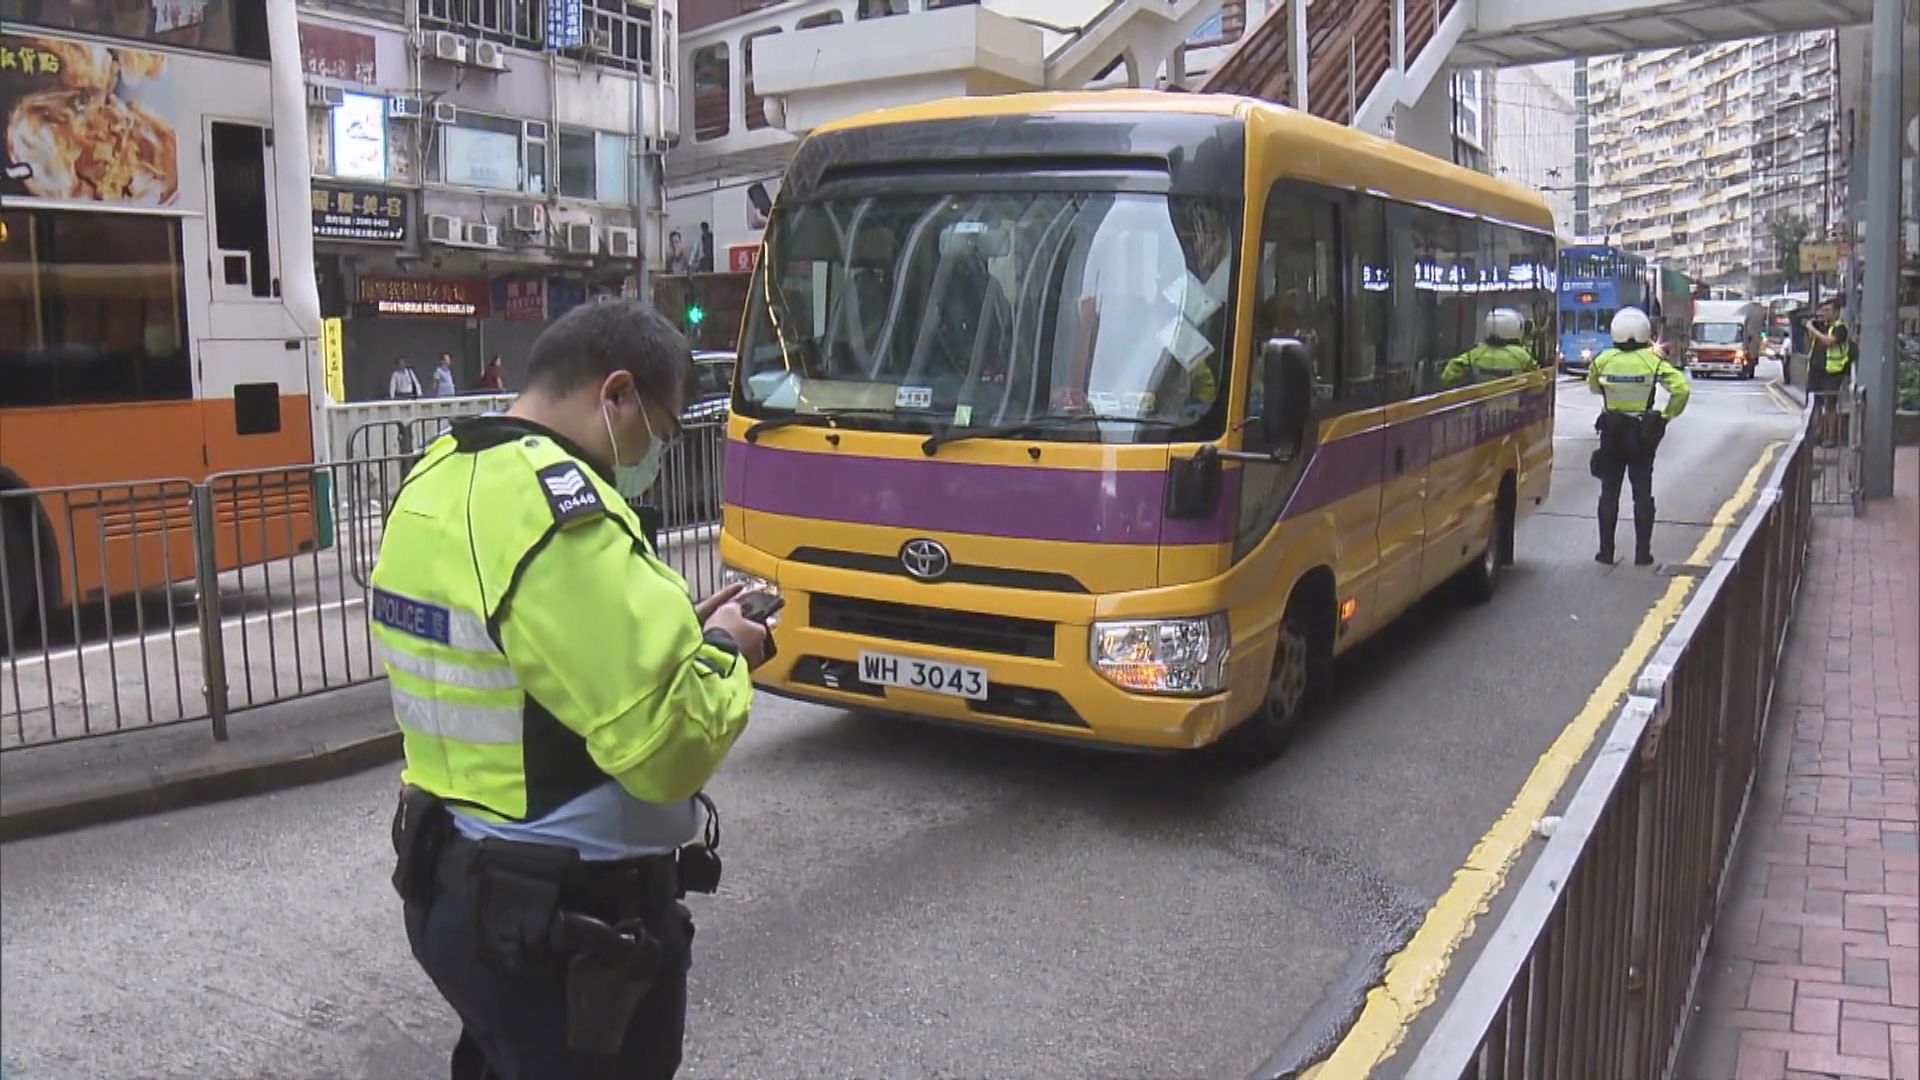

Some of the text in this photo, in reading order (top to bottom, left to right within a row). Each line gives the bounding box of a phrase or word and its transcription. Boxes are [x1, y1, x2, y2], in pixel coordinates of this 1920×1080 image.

[375, 594, 426, 634] POLICE
[864, 655, 982, 695] WH 3043
